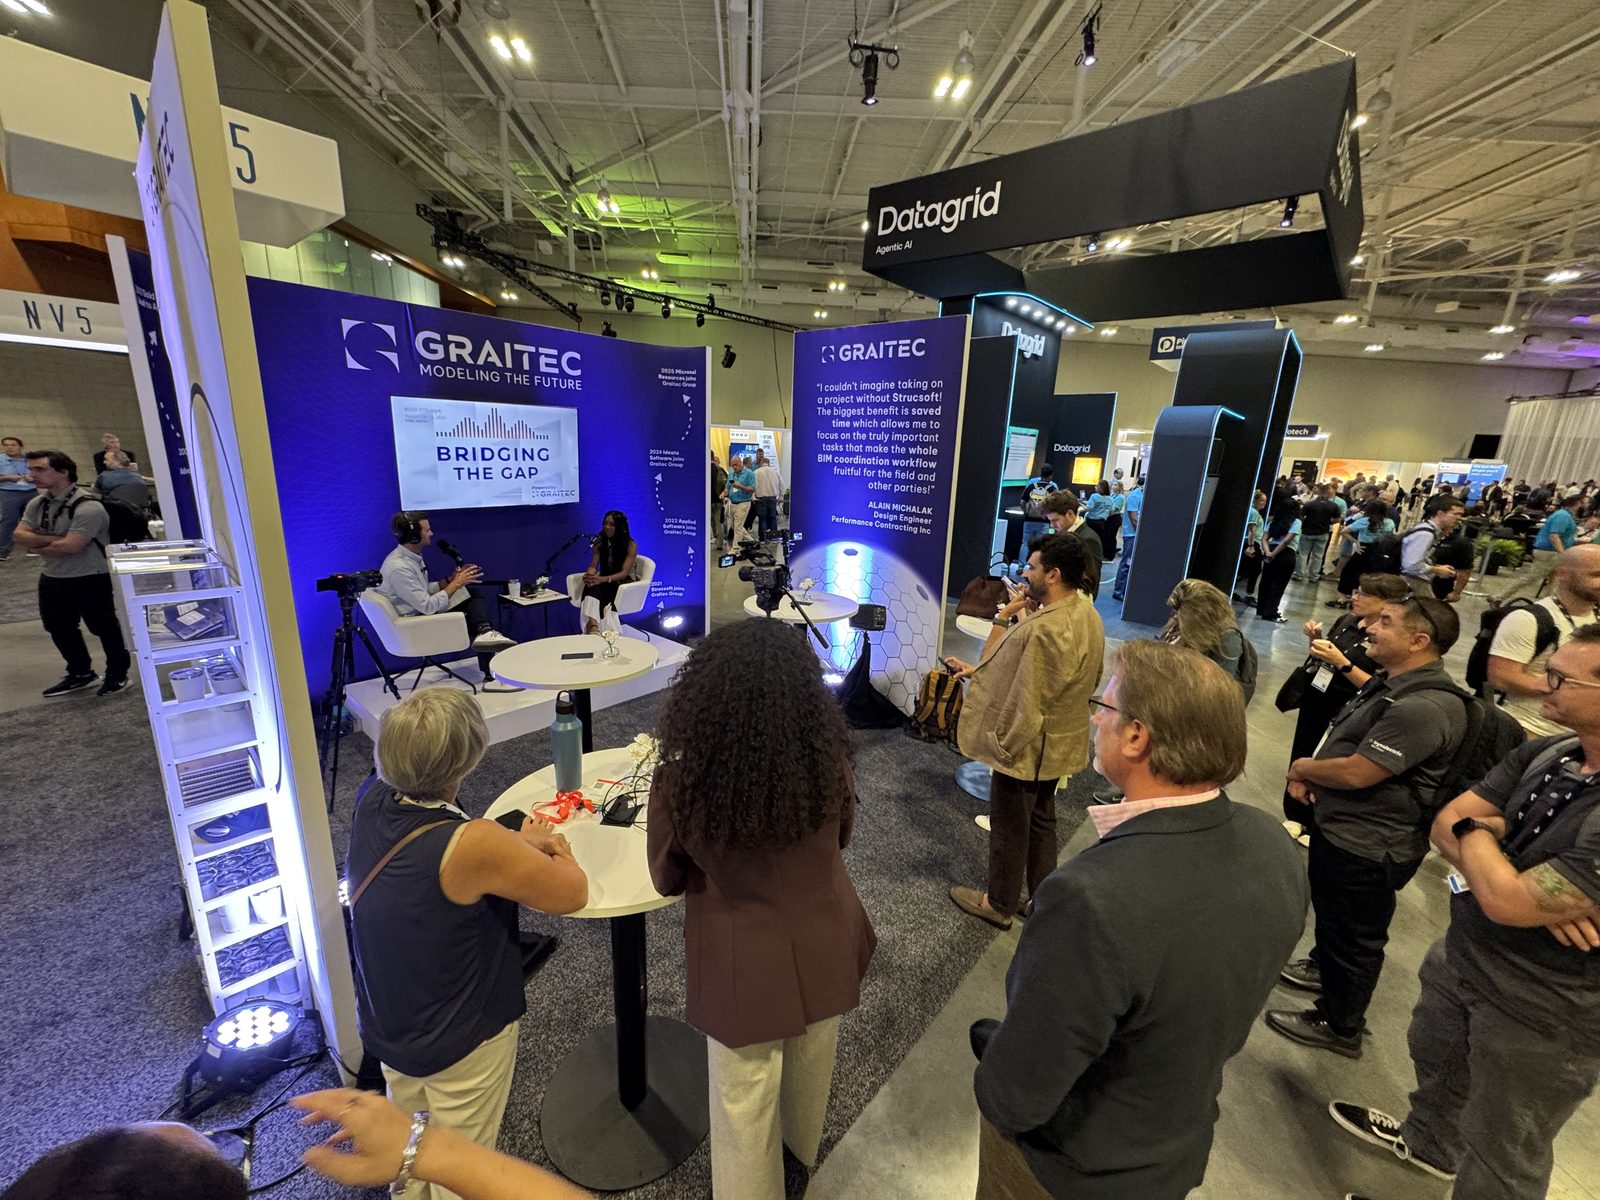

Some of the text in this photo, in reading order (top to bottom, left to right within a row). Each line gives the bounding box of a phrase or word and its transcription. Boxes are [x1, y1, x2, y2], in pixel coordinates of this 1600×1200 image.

[878, 181, 1002, 236] Datagrid
[876, 240, 912, 255] Agentic AI
[415, 330, 582, 376] GRAITEC
[839, 338, 926, 362] GRAITEC
[419, 364, 582, 390] MODELING THE FUTURE
[860, 380, 895, 392] imagine
[898, 379, 928, 391] taking
[931, 380, 943, 388] on
[824, 395, 854, 405] project
[856, 393, 890, 403] without
[892, 392, 942, 402] Strucsoft!
[817, 406, 941, 417] The biggest benefit is saved
[832, 419, 850, 428] time
[853, 419, 878, 428] which
[880, 419, 910, 428] allows
[930, 420, 940, 428] to
[817, 431, 839, 439] focus
[853, 431, 867, 440] the
[869, 432, 889, 442] truly
[892, 432, 939, 443] important
[436, 446, 550, 462] BRIDGING
[822, 443, 938, 455] tasks that make the whole
[1054, 444, 1091, 454] Datagrid
[818, 454, 937, 468] BIM coordination workflow
[453, 467, 538, 480] THE GAP
[833, 466, 936, 481] fruitful for the field and
[868, 481, 892, 490] other
[868, 501, 933, 515] ALAIN MICHALAK
[874, 511, 932, 525] Design Engineer
[832, 516, 931, 535] Performance Contracting Inc
